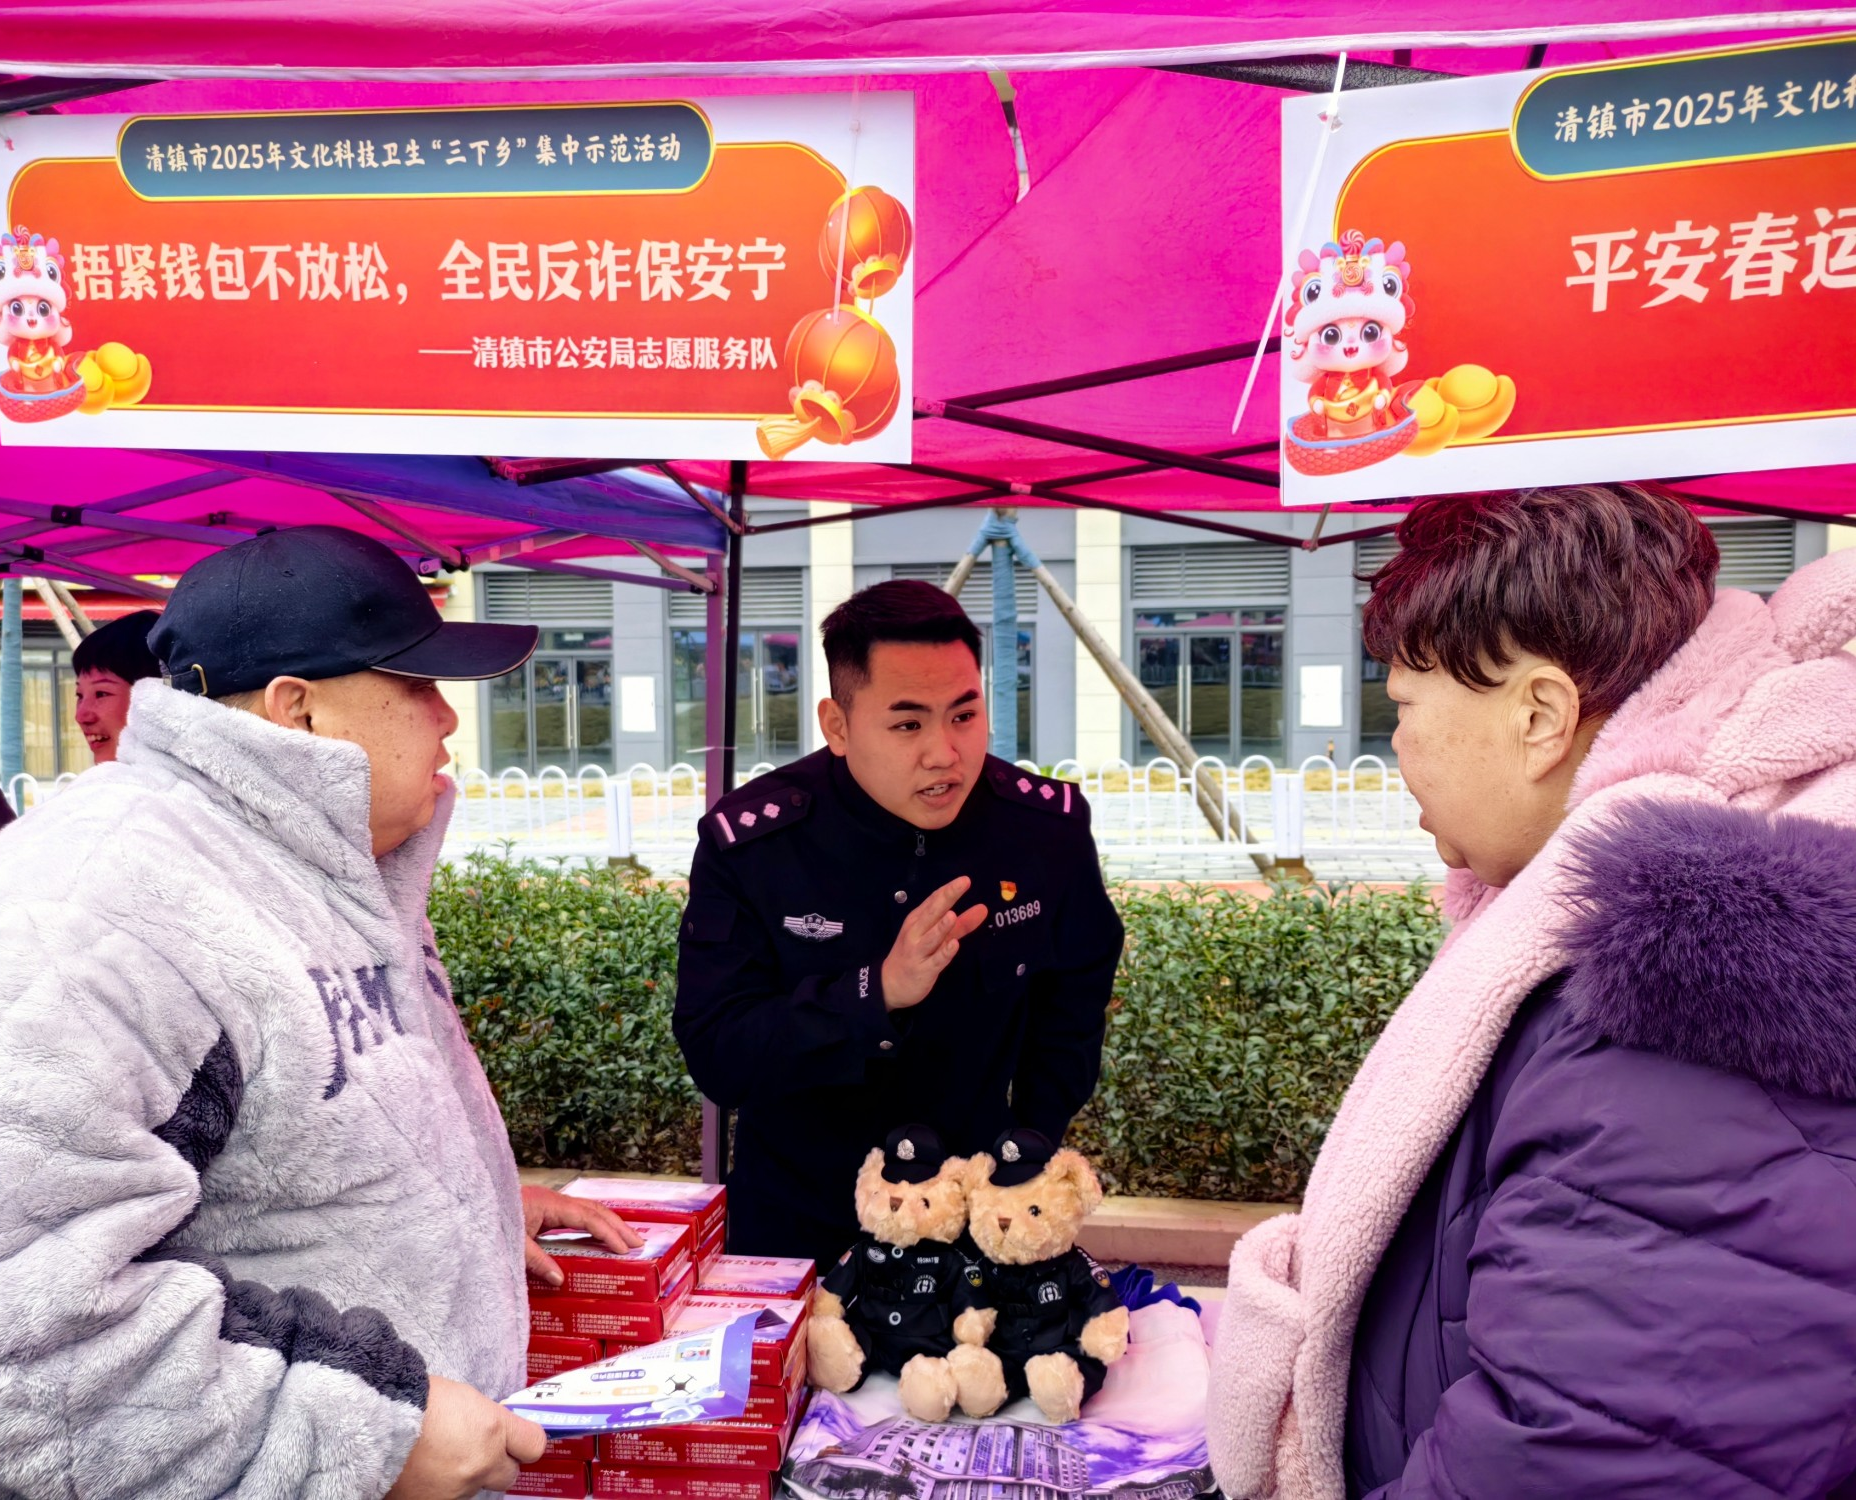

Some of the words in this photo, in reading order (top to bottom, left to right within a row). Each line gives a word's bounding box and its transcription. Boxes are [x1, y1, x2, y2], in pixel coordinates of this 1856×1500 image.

[145, 132, 682, 173] 清镇市2025年文化科技卫生“三下乡”集中示范活动
[995, 900, 1041, 928] 013689
[859, 965, 870, 999] POLICE
